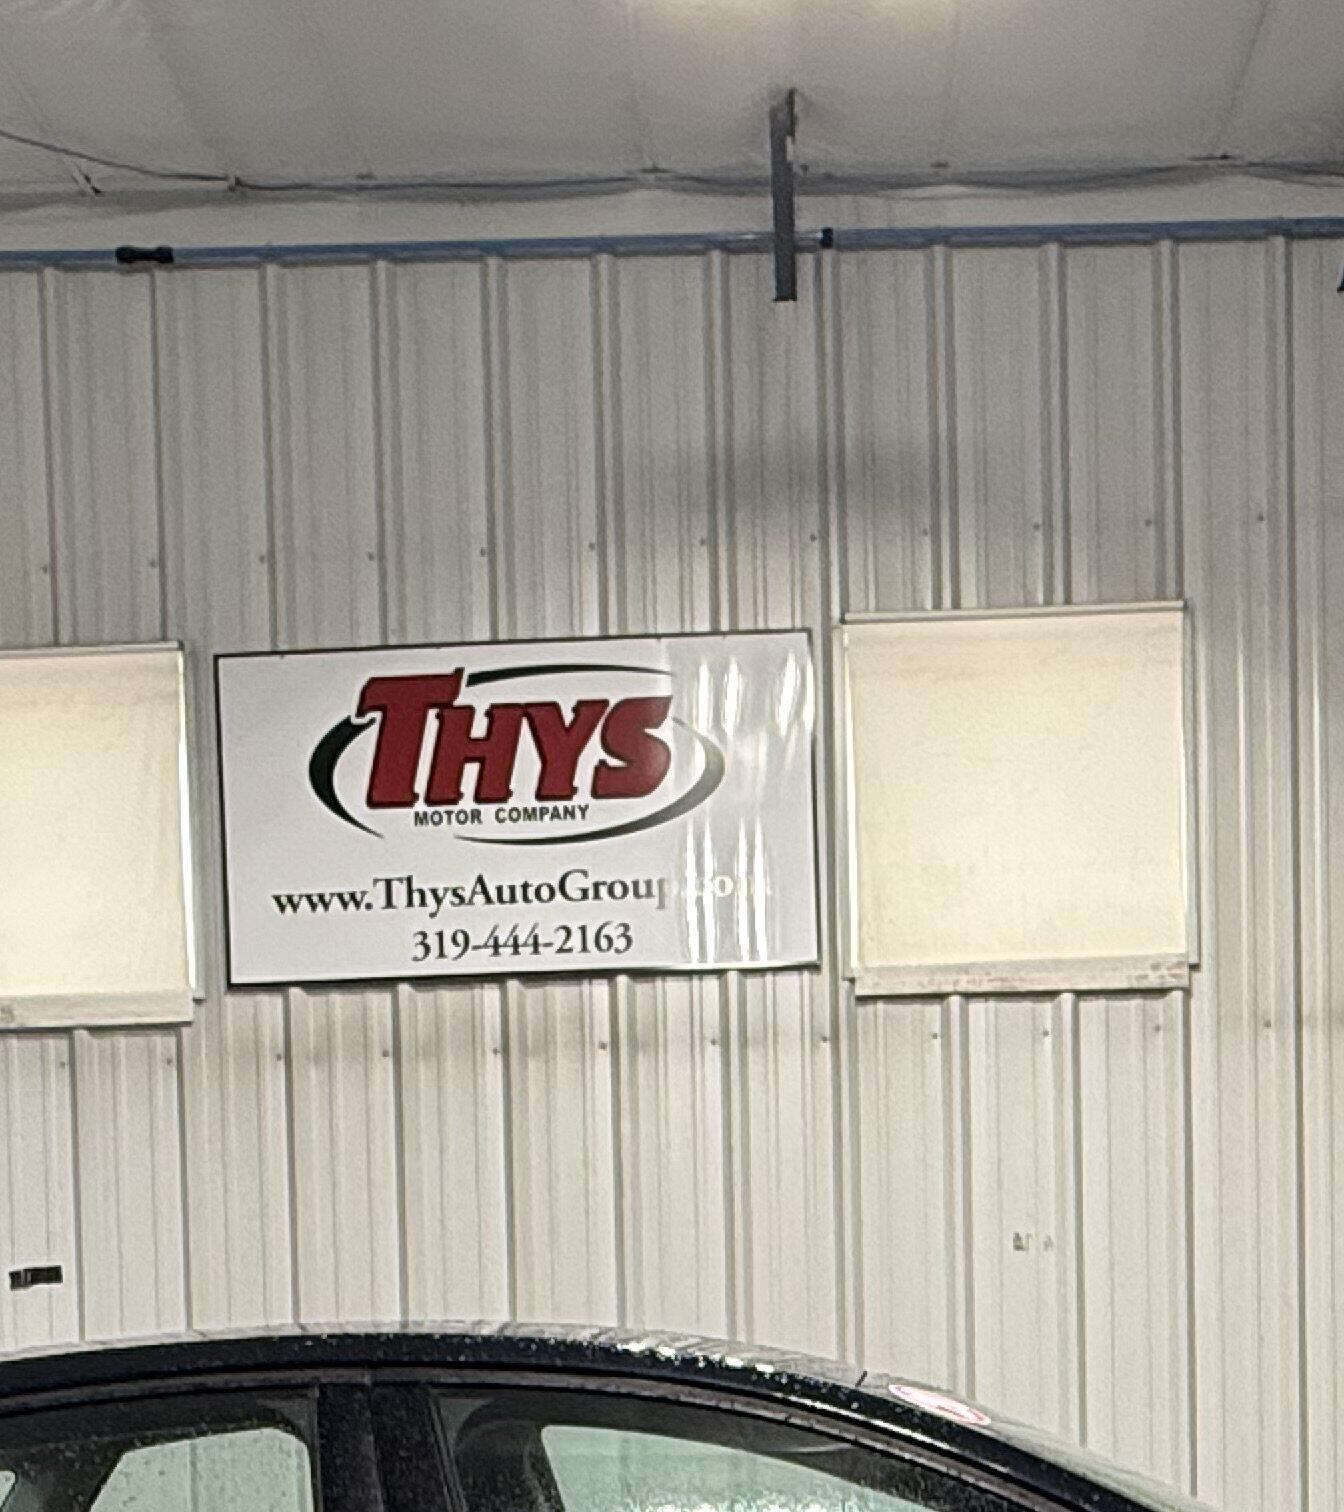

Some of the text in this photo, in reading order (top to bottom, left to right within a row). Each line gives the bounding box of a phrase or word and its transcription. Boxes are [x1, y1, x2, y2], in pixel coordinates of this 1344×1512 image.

[356, 667, 673, 809] THYS
[414, 803, 590, 827] MOTOR COMPANY
[271, 868, 772, 919] www.ThysAutoGroup.o
[411, 920, 634, 962] 319-444-2163
